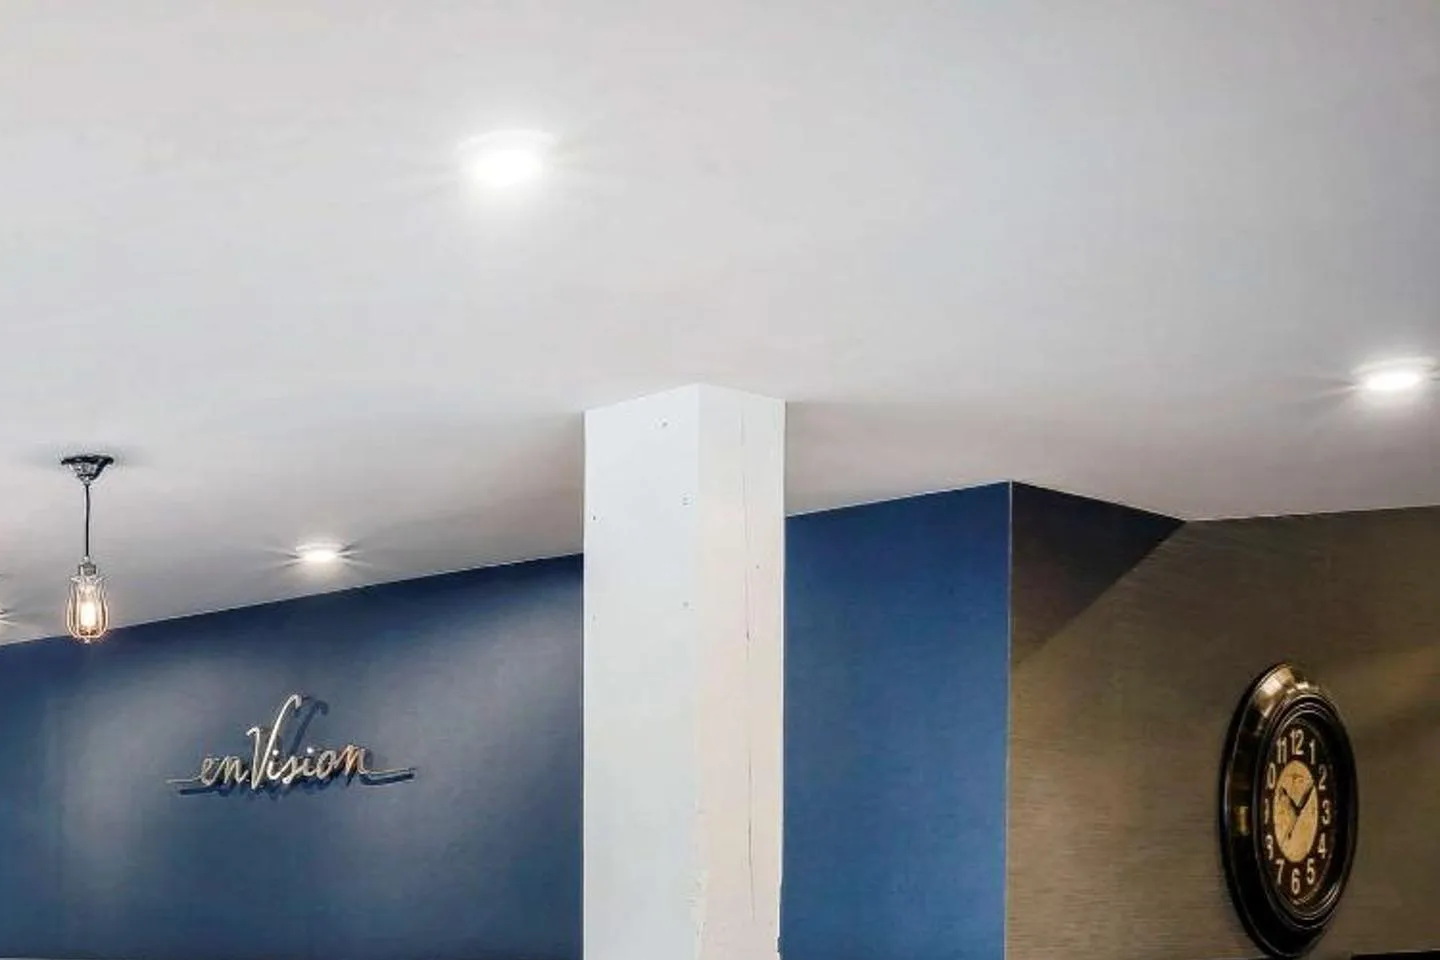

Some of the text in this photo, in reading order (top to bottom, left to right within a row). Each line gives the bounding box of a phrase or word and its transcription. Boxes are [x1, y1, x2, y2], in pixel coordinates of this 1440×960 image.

[165, 693, 416, 790] enVision
[1276, 736, 1287, 764] 11
[1290, 729, 1304, 755] 12
[1309, 739, 1316, 765] 1
[1318, 764, 1327, 790] 2
[1322, 799, 1331, 825] 3
[1318, 833, 1327, 858] 4
[1275, 859, 1285, 885] 7
[1291, 867, 1300, 895] 6
[1307, 858, 1315, 884] 5
